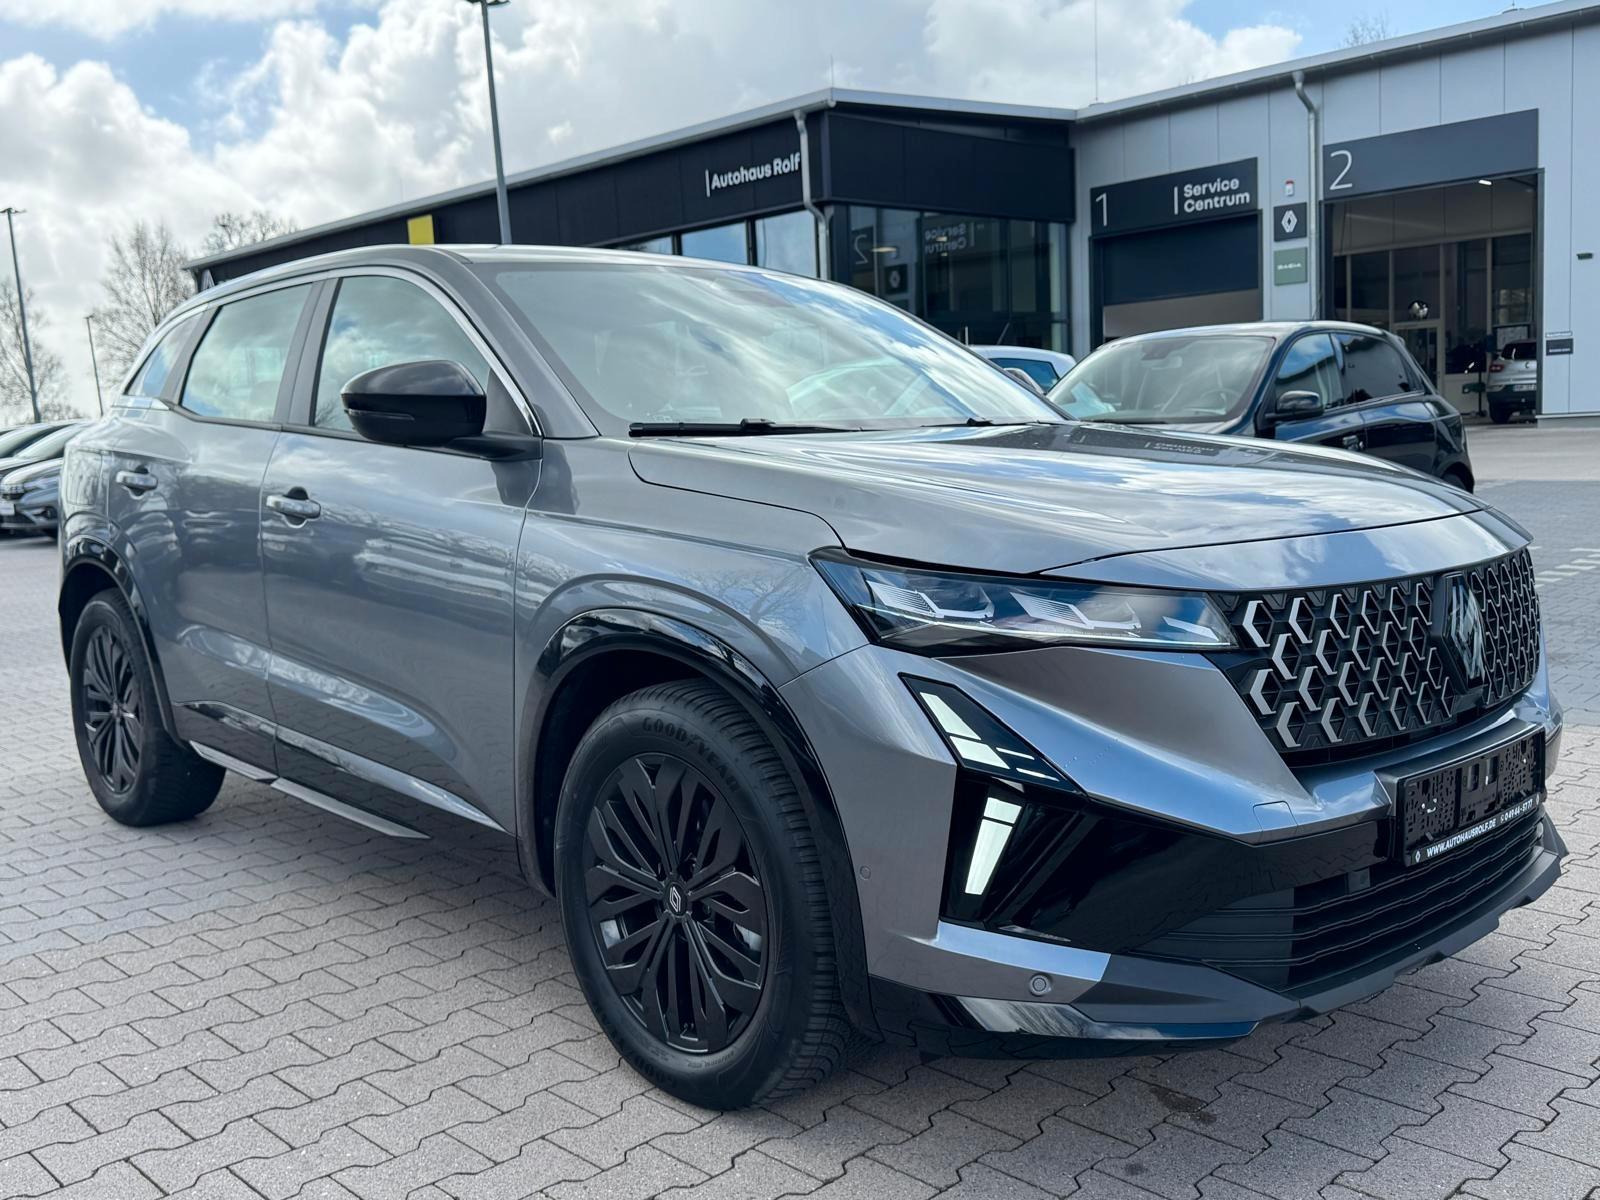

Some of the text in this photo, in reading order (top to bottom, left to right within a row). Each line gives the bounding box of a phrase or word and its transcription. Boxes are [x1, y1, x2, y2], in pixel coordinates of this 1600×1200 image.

[711, 152, 800, 190] Autohaus Rolf
[1183, 177, 1240, 198] Service
[1329, 149, 1353, 191] 2
[1095, 192, 1108, 227] 1
[1183, 191, 1250, 214] Centrum
[1426, 818, 1497, 858] WWW.AUTOHAUSROLF.DE
